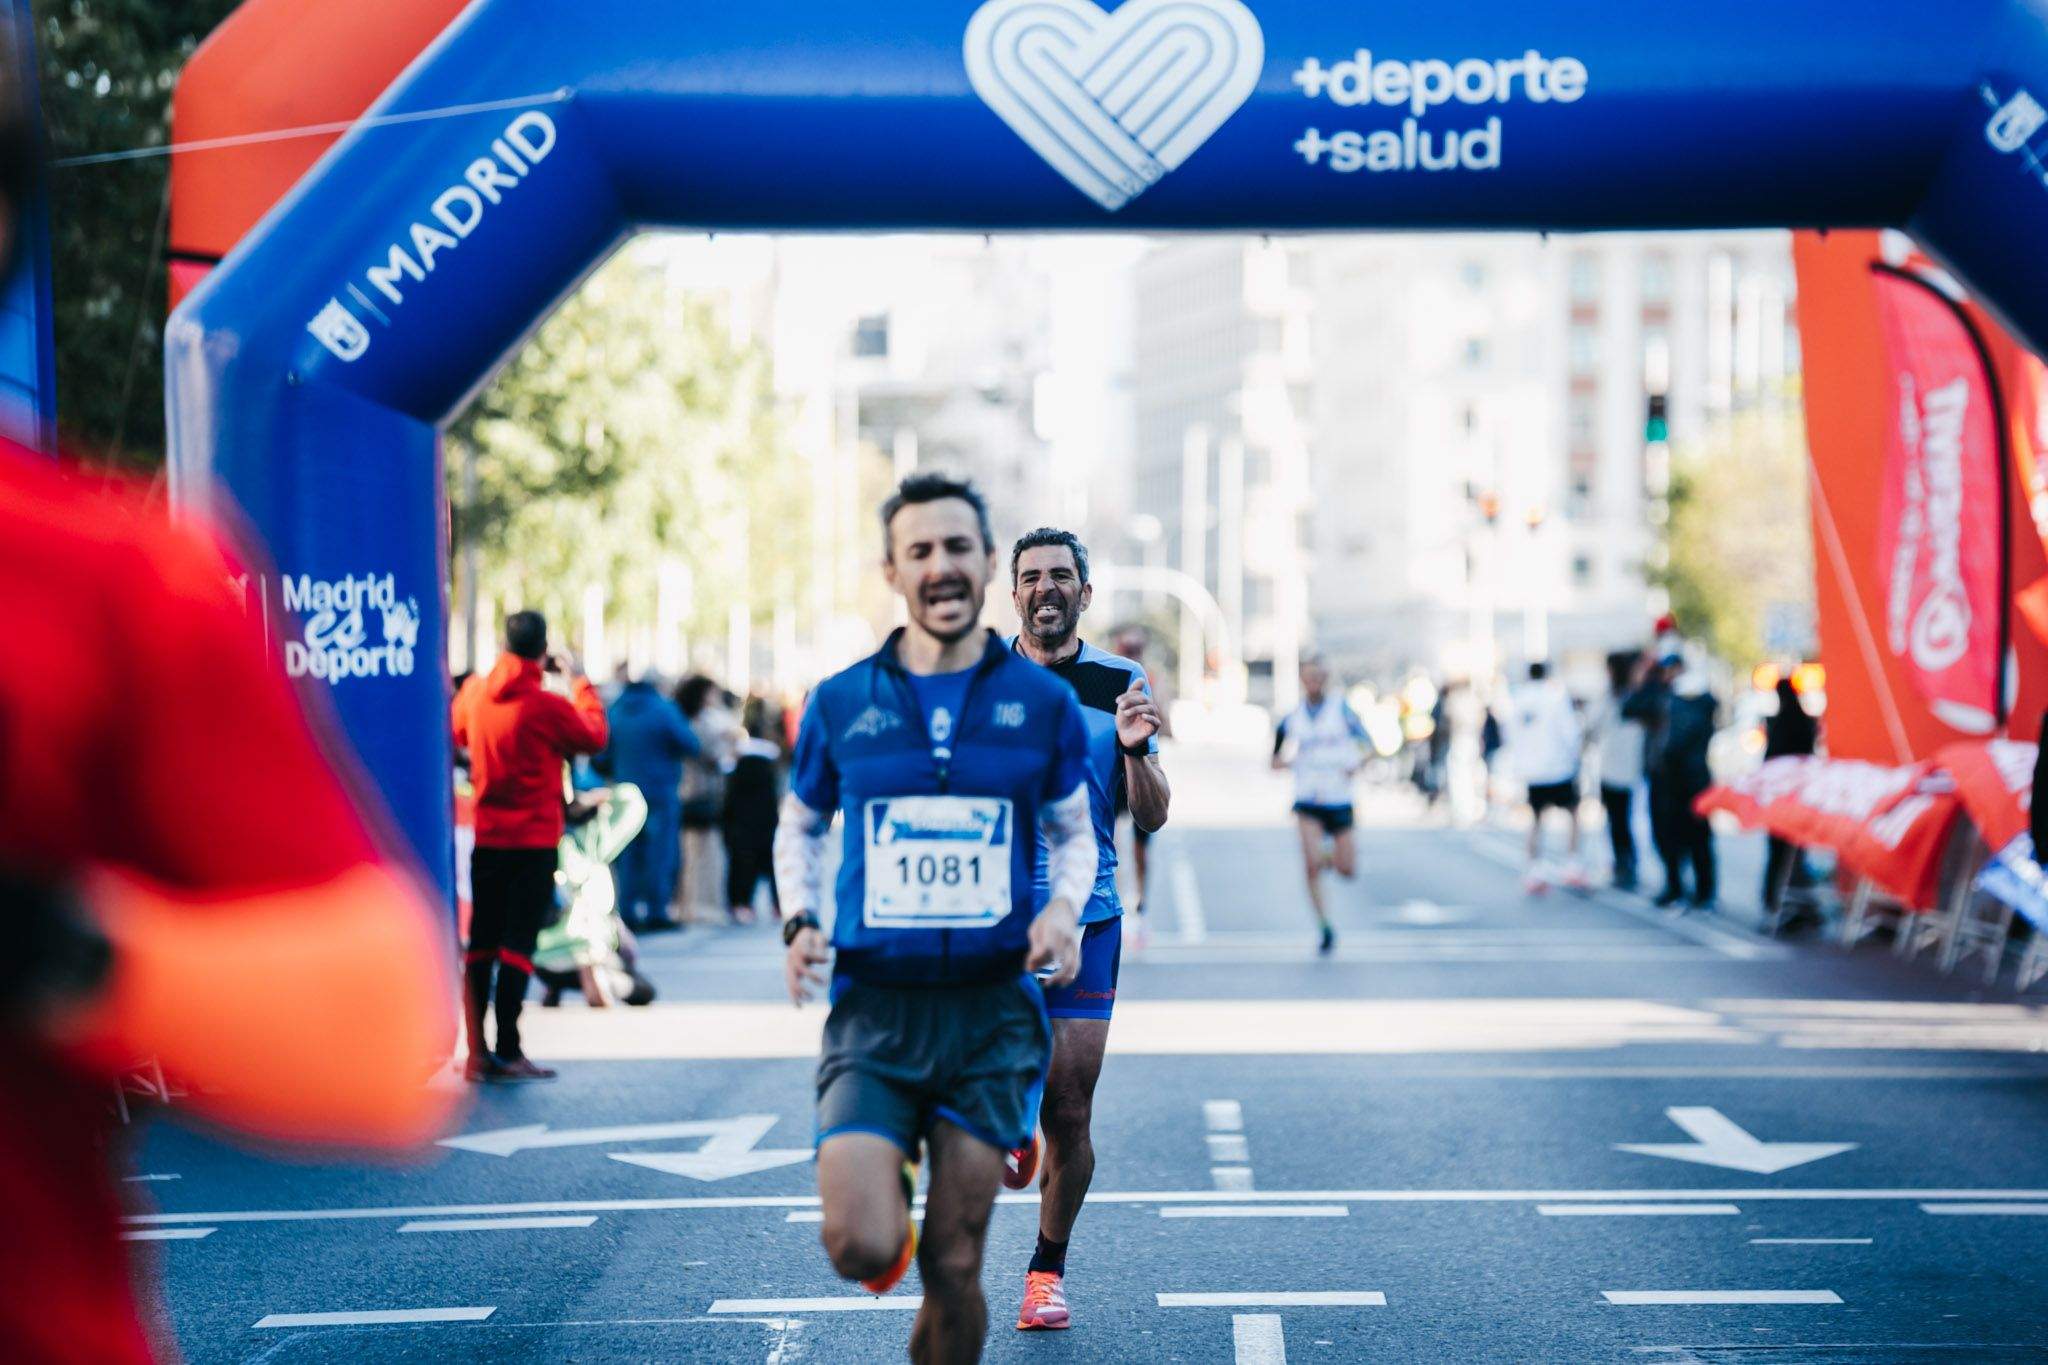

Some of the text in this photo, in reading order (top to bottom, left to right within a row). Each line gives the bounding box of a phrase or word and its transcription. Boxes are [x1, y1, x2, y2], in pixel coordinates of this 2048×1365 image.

[1293, 48, 1588, 116] +deporte
[1294, 116, 1502, 171] +salud
[366, 111, 557, 304] MADRID
[282, 572, 396, 612] Madrid
[285, 641, 415, 685] Deporte
[896, 853, 982, 886] 1081
